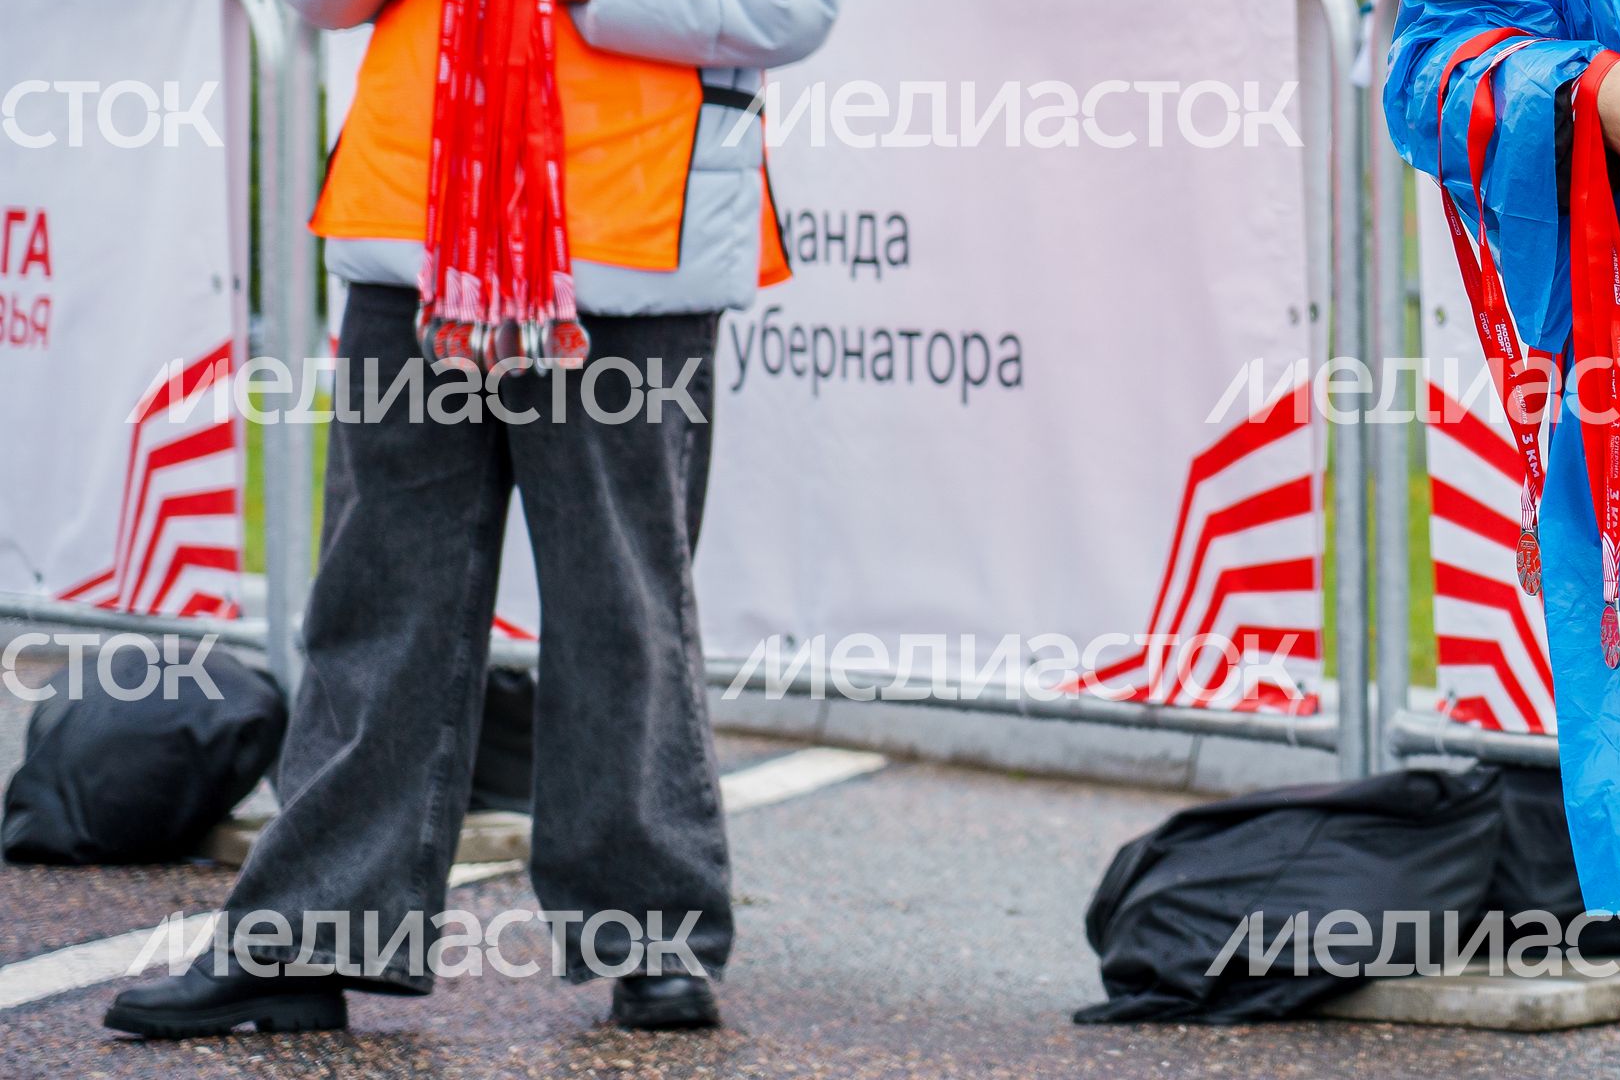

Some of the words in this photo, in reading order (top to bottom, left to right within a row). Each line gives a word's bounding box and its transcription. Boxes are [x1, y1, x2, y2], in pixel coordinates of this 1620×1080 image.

[1495, 324, 1507, 353] СПОРТ
[1499, 323, 1515, 360] МОСОБЛ
[1521, 433, 1534, 445] 3
[1525, 449, 1541, 478] КМ
